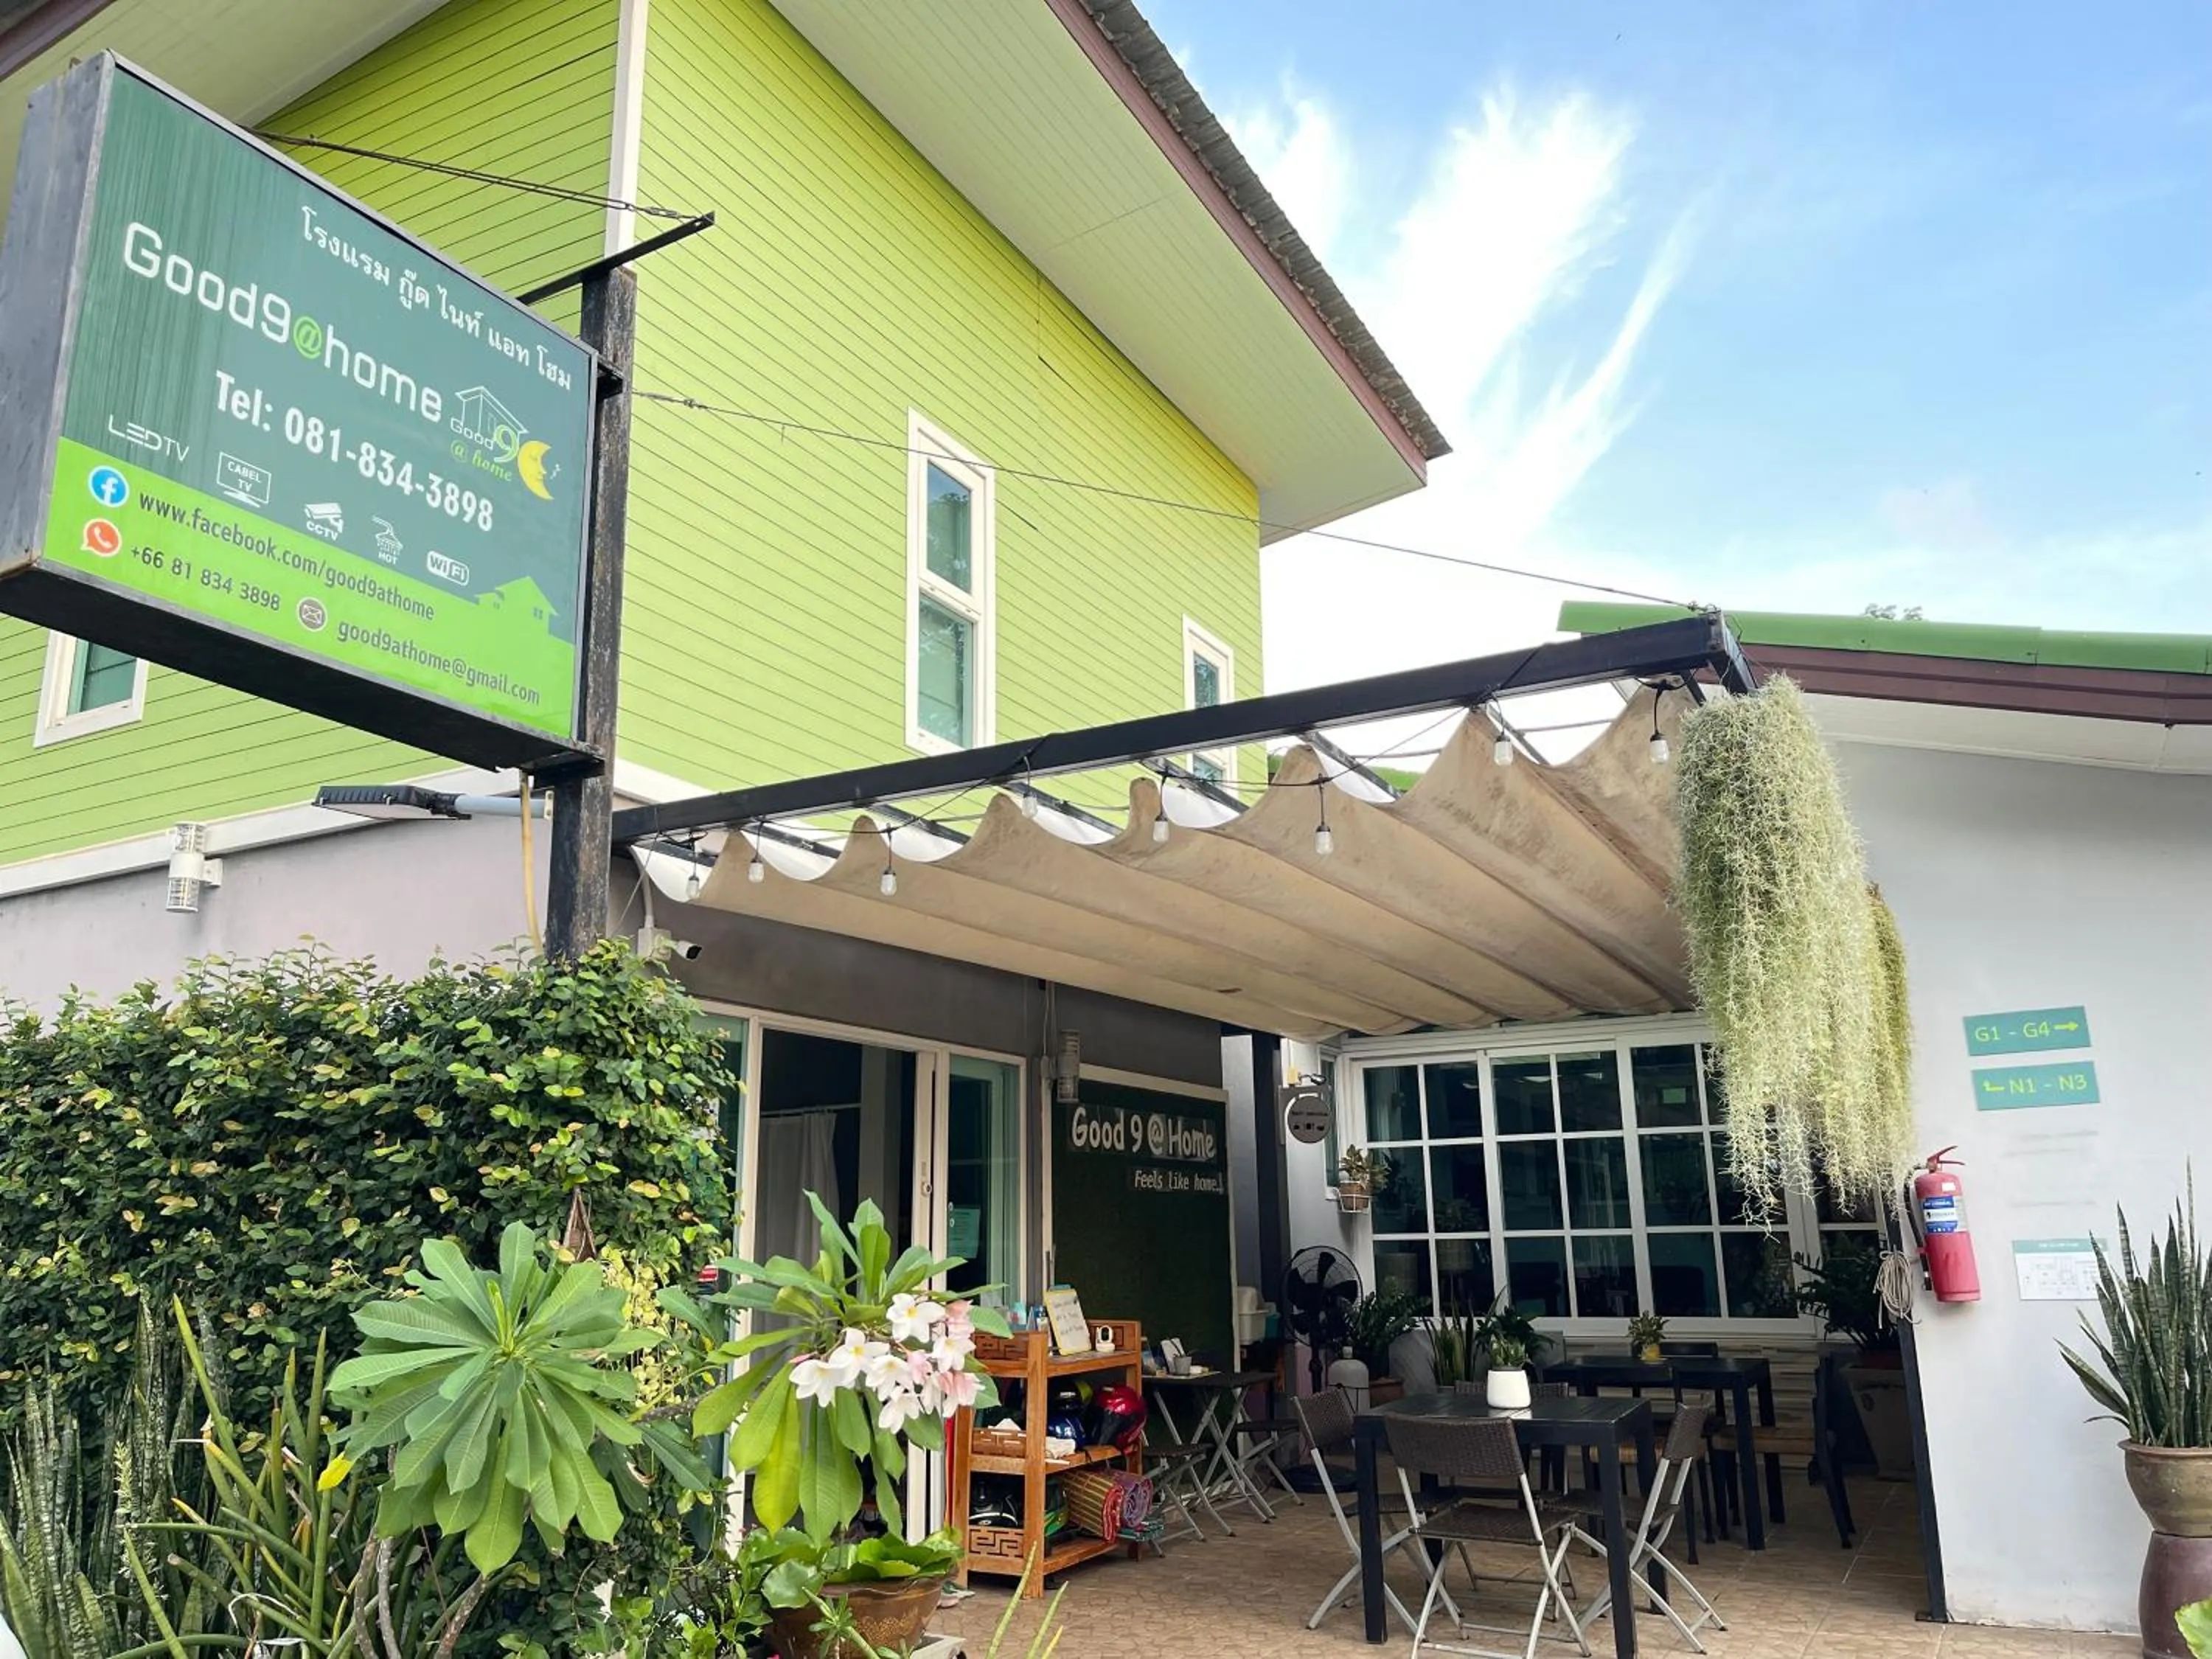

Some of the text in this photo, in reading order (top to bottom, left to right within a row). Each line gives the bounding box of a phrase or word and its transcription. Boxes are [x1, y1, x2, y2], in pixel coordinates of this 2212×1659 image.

[302, 206, 389, 285] โรงแรม
[536, 344, 571, 390] โฮม
[215, 369, 493, 532] Tel: 081-834-3898
[227, 461, 262, 484] CABEL
[237, 479, 252, 492] TV
[306, 521, 338, 540] CCTV
[140, 493, 435, 621] www.facebook.com/good9athome
[131, 546, 281, 611] +66 81 834 3898
[337, 621, 540, 706] good9athome@gmail.com
[1975, 1026, 2000, 1042] G1
[2023, 1021, 2051, 1037] G4
[2008, 1078, 2037, 1094] N1
[2059, 1074, 2087, 1091] N3
[1072, 1107, 1125, 1150] Good
[1130, 1114, 1143, 1152] 9
[1135, 1170, 1163, 1189] Feels
